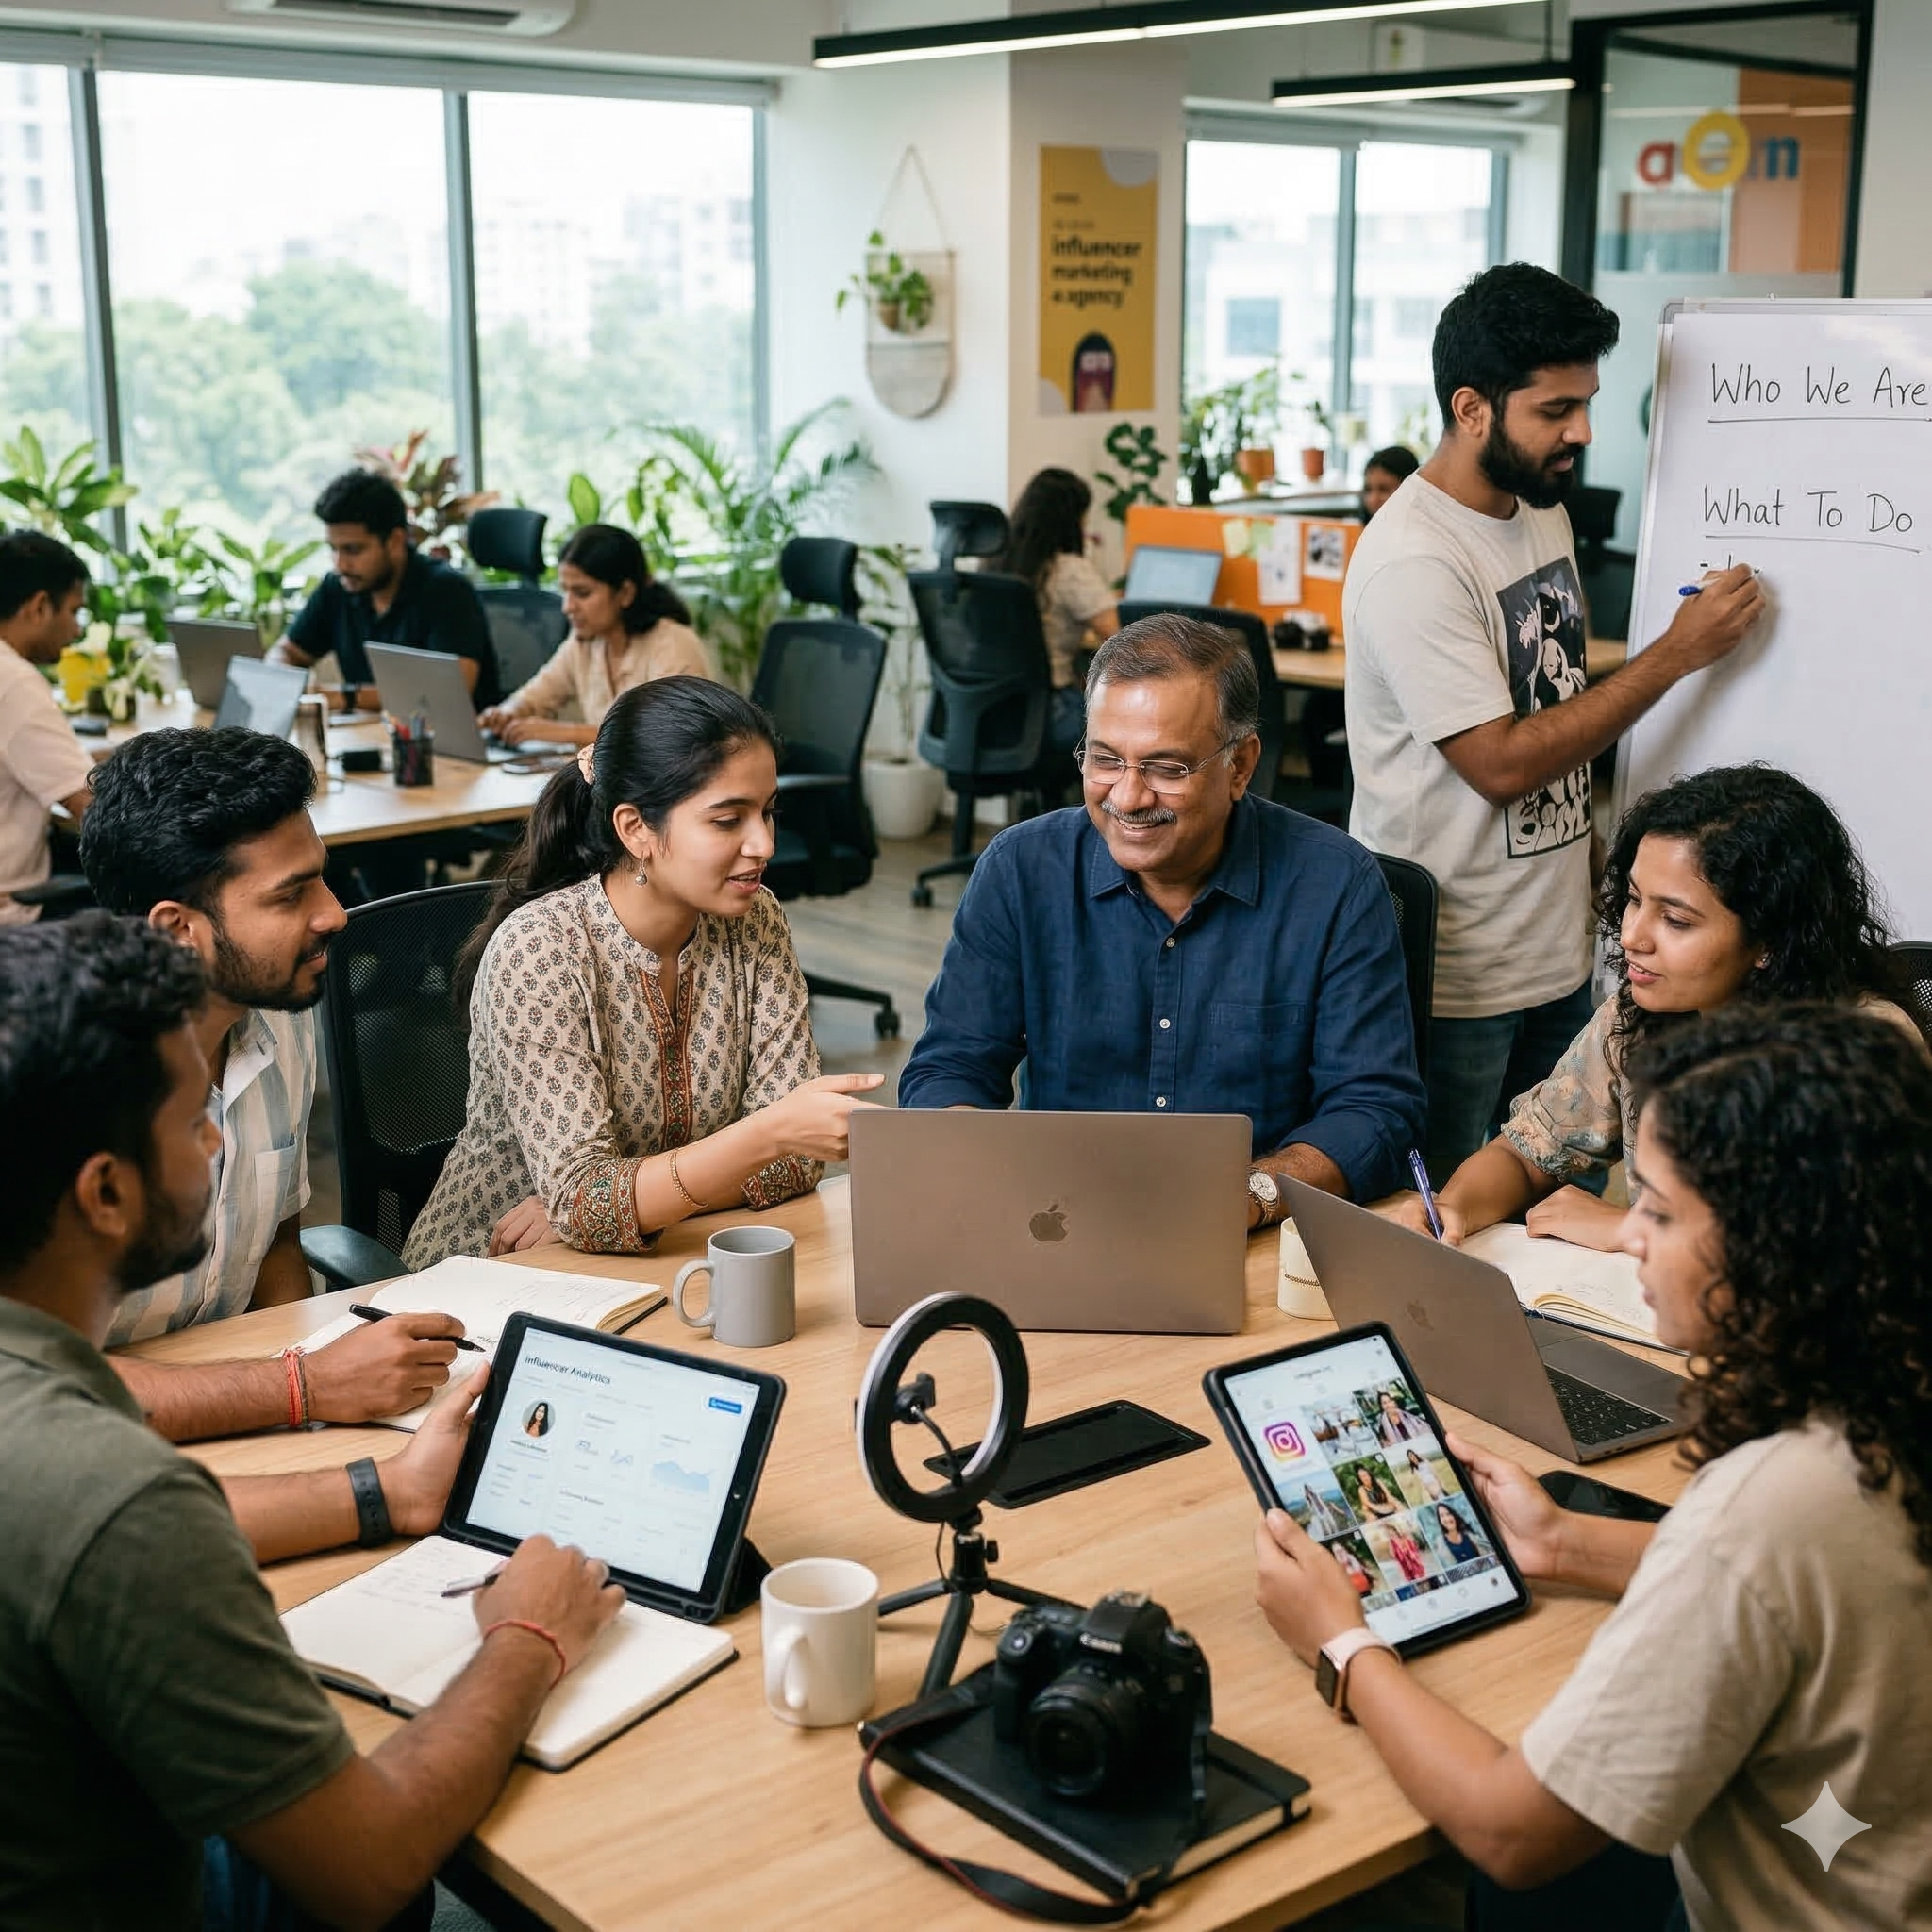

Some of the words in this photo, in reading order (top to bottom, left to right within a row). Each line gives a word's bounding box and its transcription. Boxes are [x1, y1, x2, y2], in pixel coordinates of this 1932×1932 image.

[1711, 362, 1781, 404] Who
[1807, 365, 1851, 404] We
[1873, 366, 1928, 408] Are
[1704, 485, 1785, 526] What
[1807, 491, 1843, 528] To
[1866, 493, 1914, 533] Do
